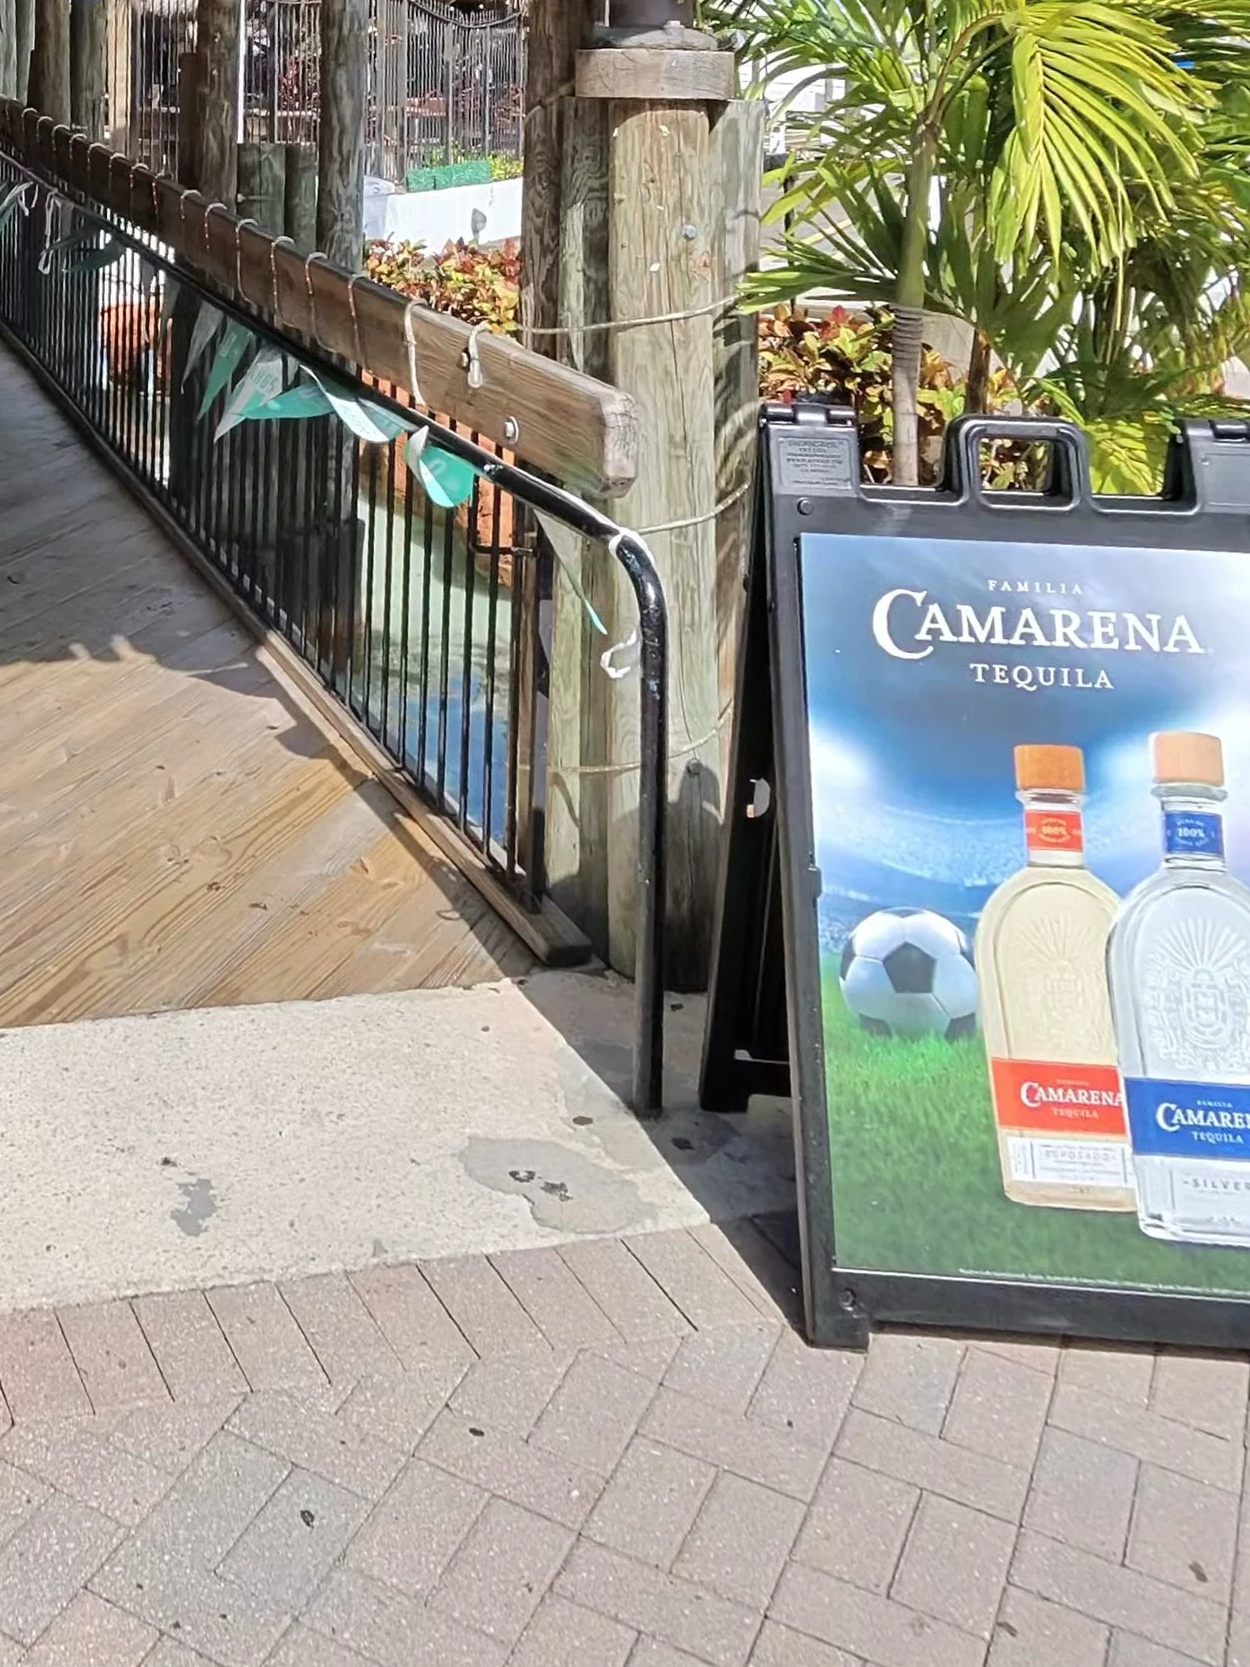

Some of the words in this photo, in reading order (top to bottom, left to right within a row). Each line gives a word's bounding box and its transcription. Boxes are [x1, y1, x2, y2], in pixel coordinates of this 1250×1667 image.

[987, 579, 1083, 595] FAMILIA
[872, 589, 1205, 660] CAMARENA
[970, 663, 1114, 691] TEQUILA
[1178, 827, 1205, 837] 100%
[1020, 1081, 1123, 1108] CAMARENA
[1052, 1107, 1099, 1119] TEQUILA
[1191, 1131, 1243, 1144] TEQUILA
